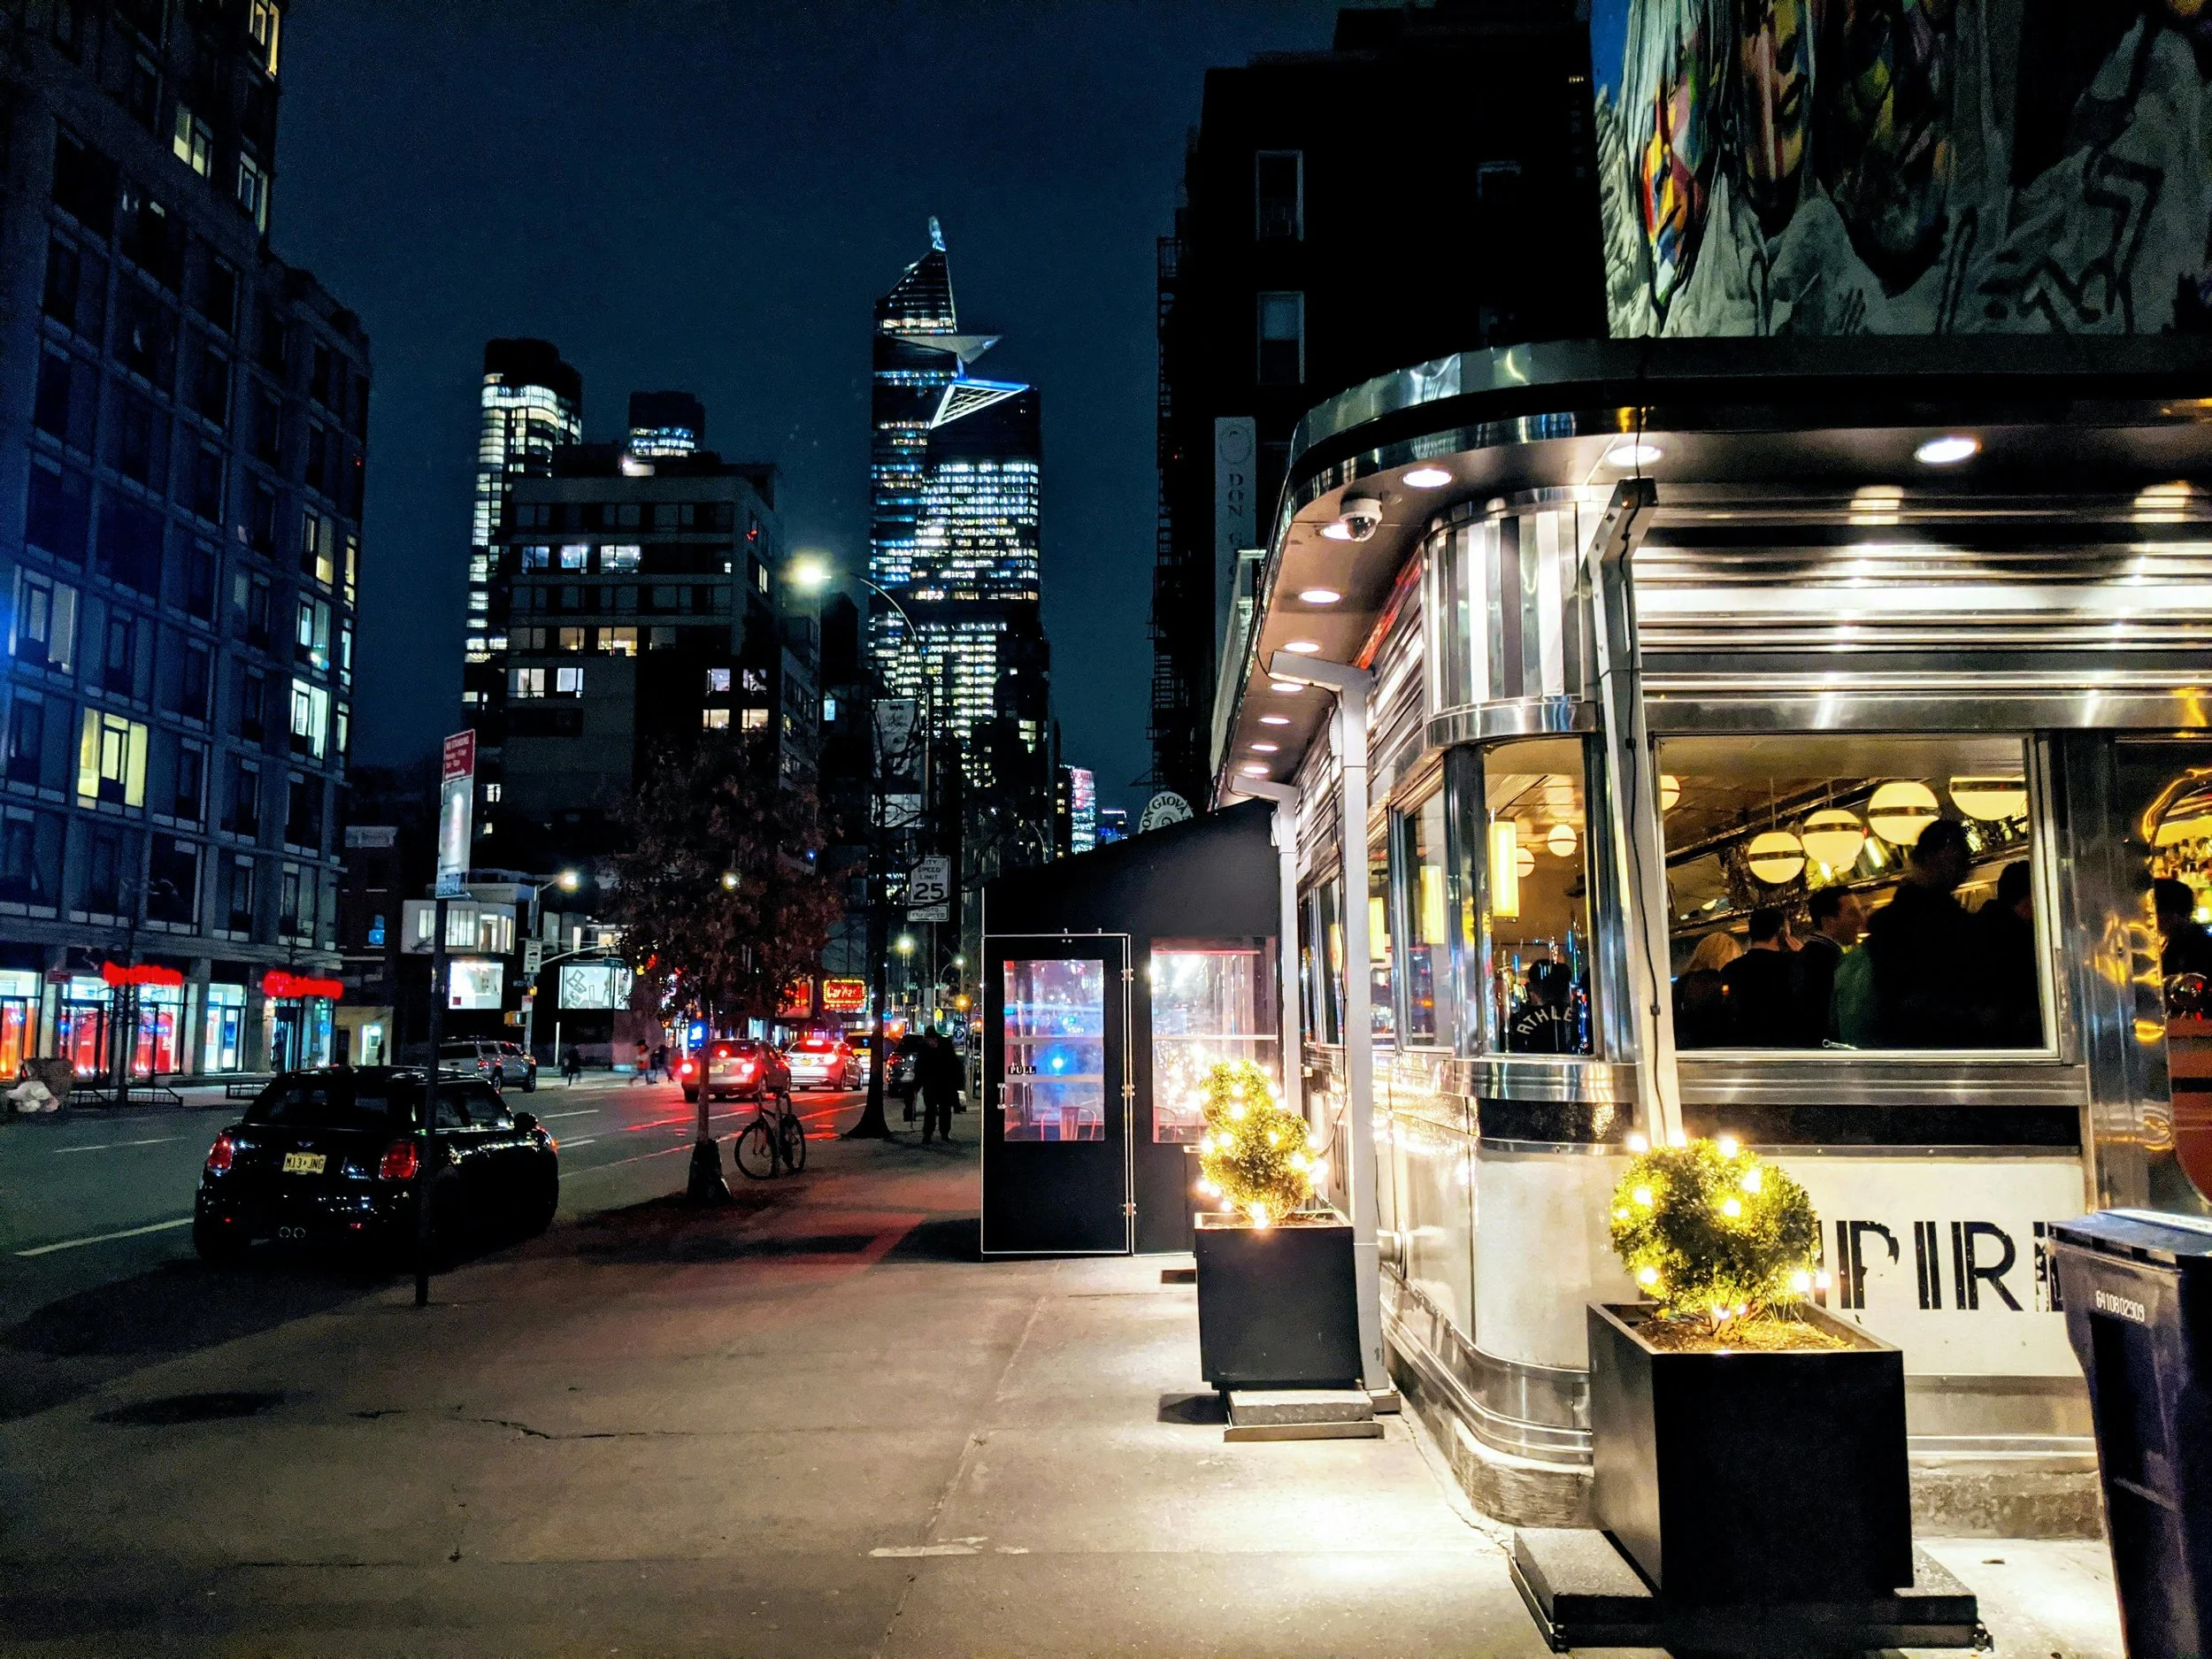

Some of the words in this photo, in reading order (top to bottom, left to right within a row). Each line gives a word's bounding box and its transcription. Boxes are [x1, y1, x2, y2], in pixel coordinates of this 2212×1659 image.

[1228, 473, 1244, 517] DON
[914, 882, 944, 900] 25
[1517, 1005, 1573, 1034] ATHLE
